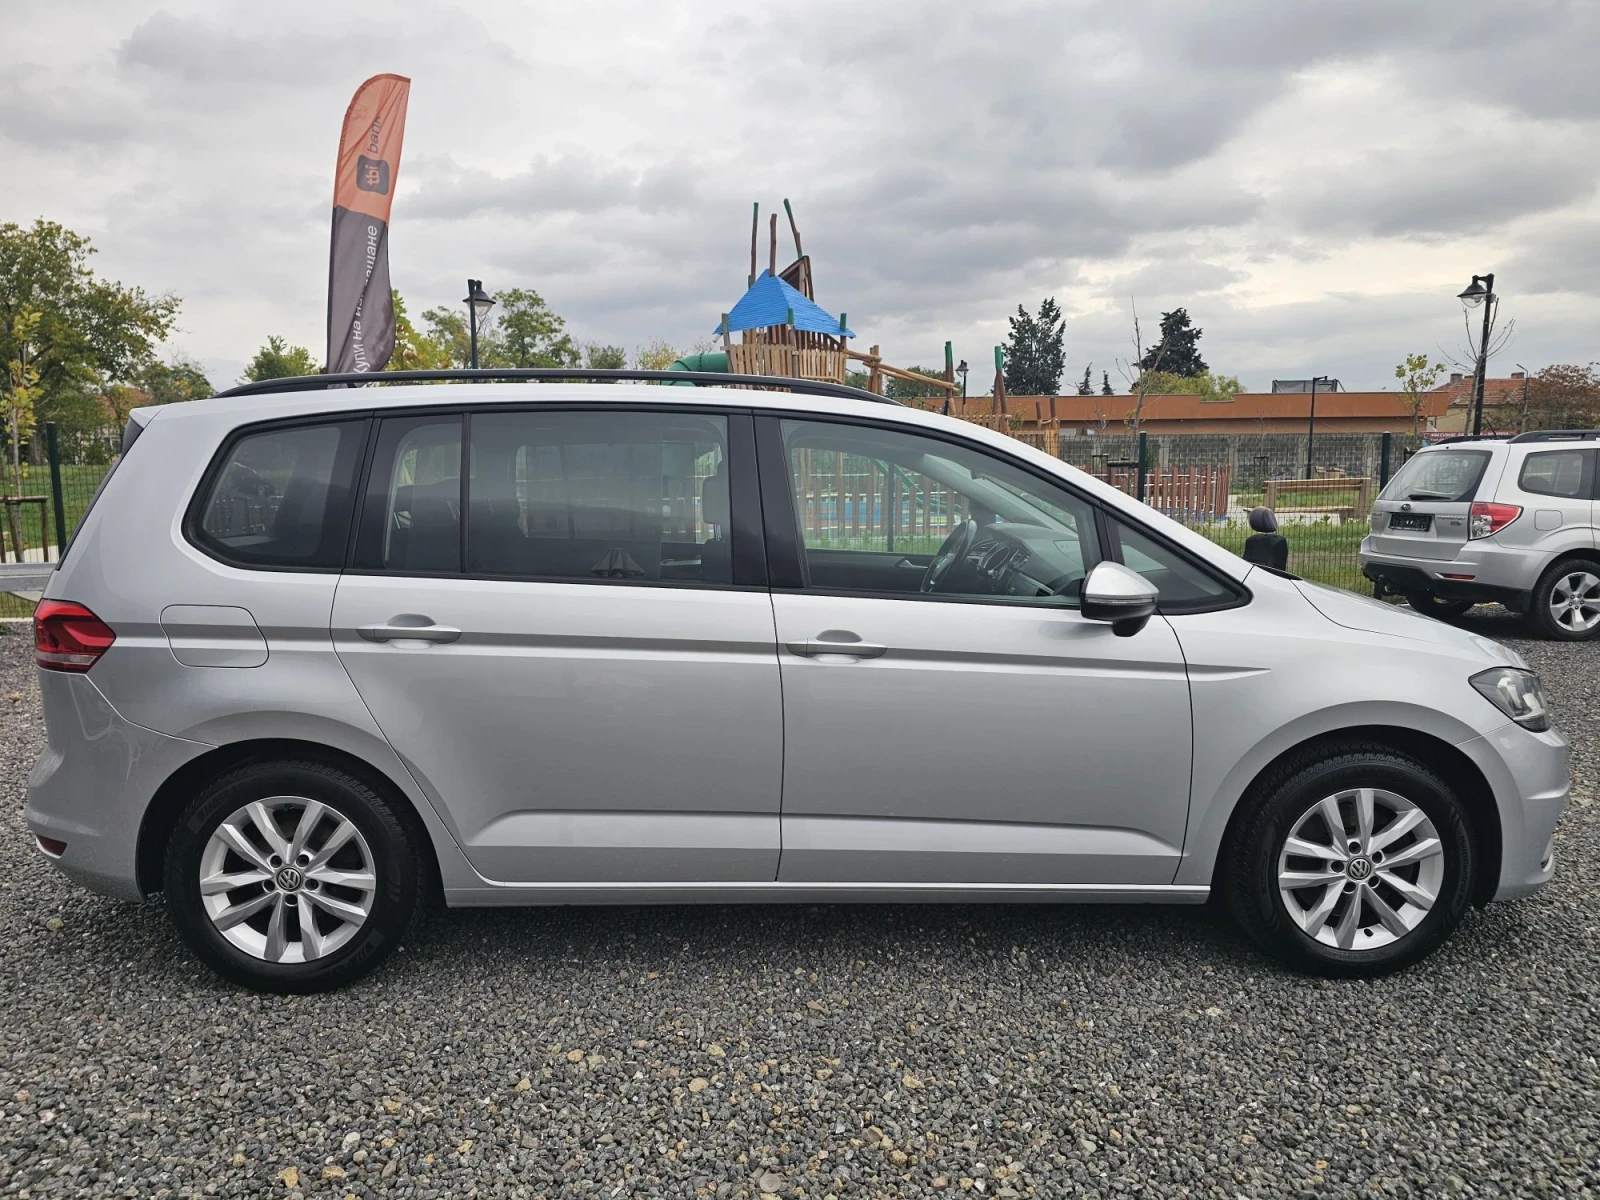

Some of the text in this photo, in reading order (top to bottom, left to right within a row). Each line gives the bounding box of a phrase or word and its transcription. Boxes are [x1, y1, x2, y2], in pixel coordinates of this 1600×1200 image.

[365, 164, 380, 187] tbi
[353, 321, 361, 340] на
[1350, 858, 1370, 879] VW
[278, 869, 300, 890] VW
